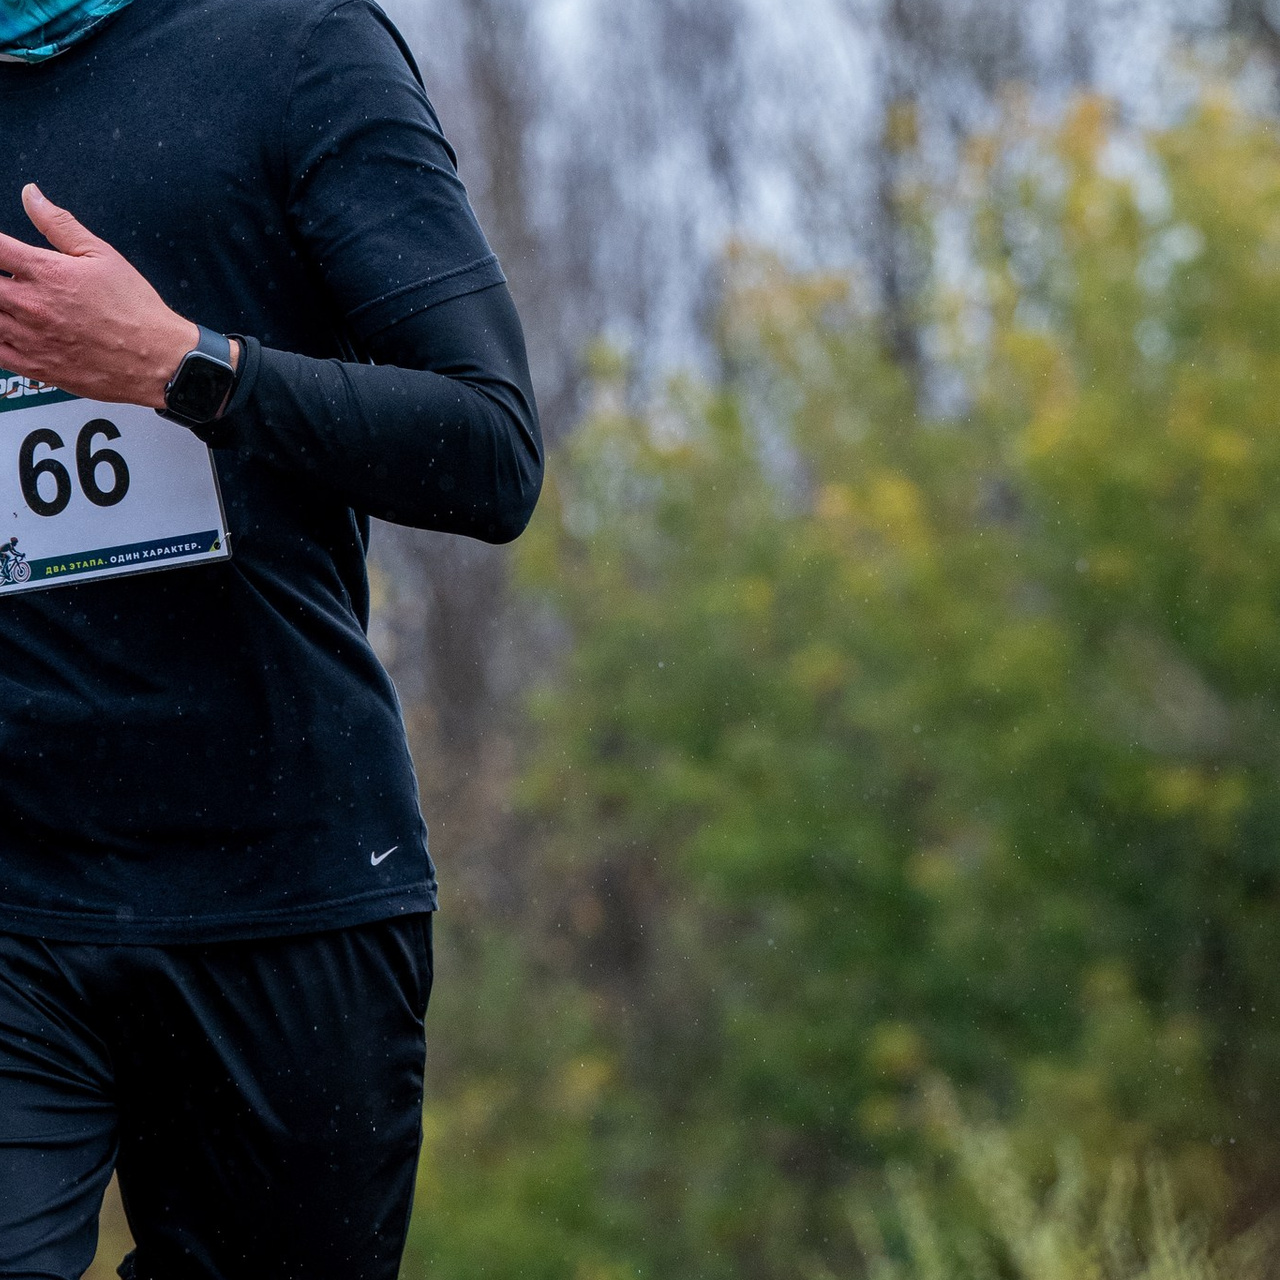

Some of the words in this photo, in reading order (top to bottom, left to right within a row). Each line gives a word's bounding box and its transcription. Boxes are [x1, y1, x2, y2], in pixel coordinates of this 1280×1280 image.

[19, 418, 130, 517] 66
[45, 564, 67, 575] ДВА
[69, 558, 108, 570] ЭТАПА.
[110, 551, 140, 563] ОДИН
[142, 542, 202, 558] ХАРАКТЕР.
